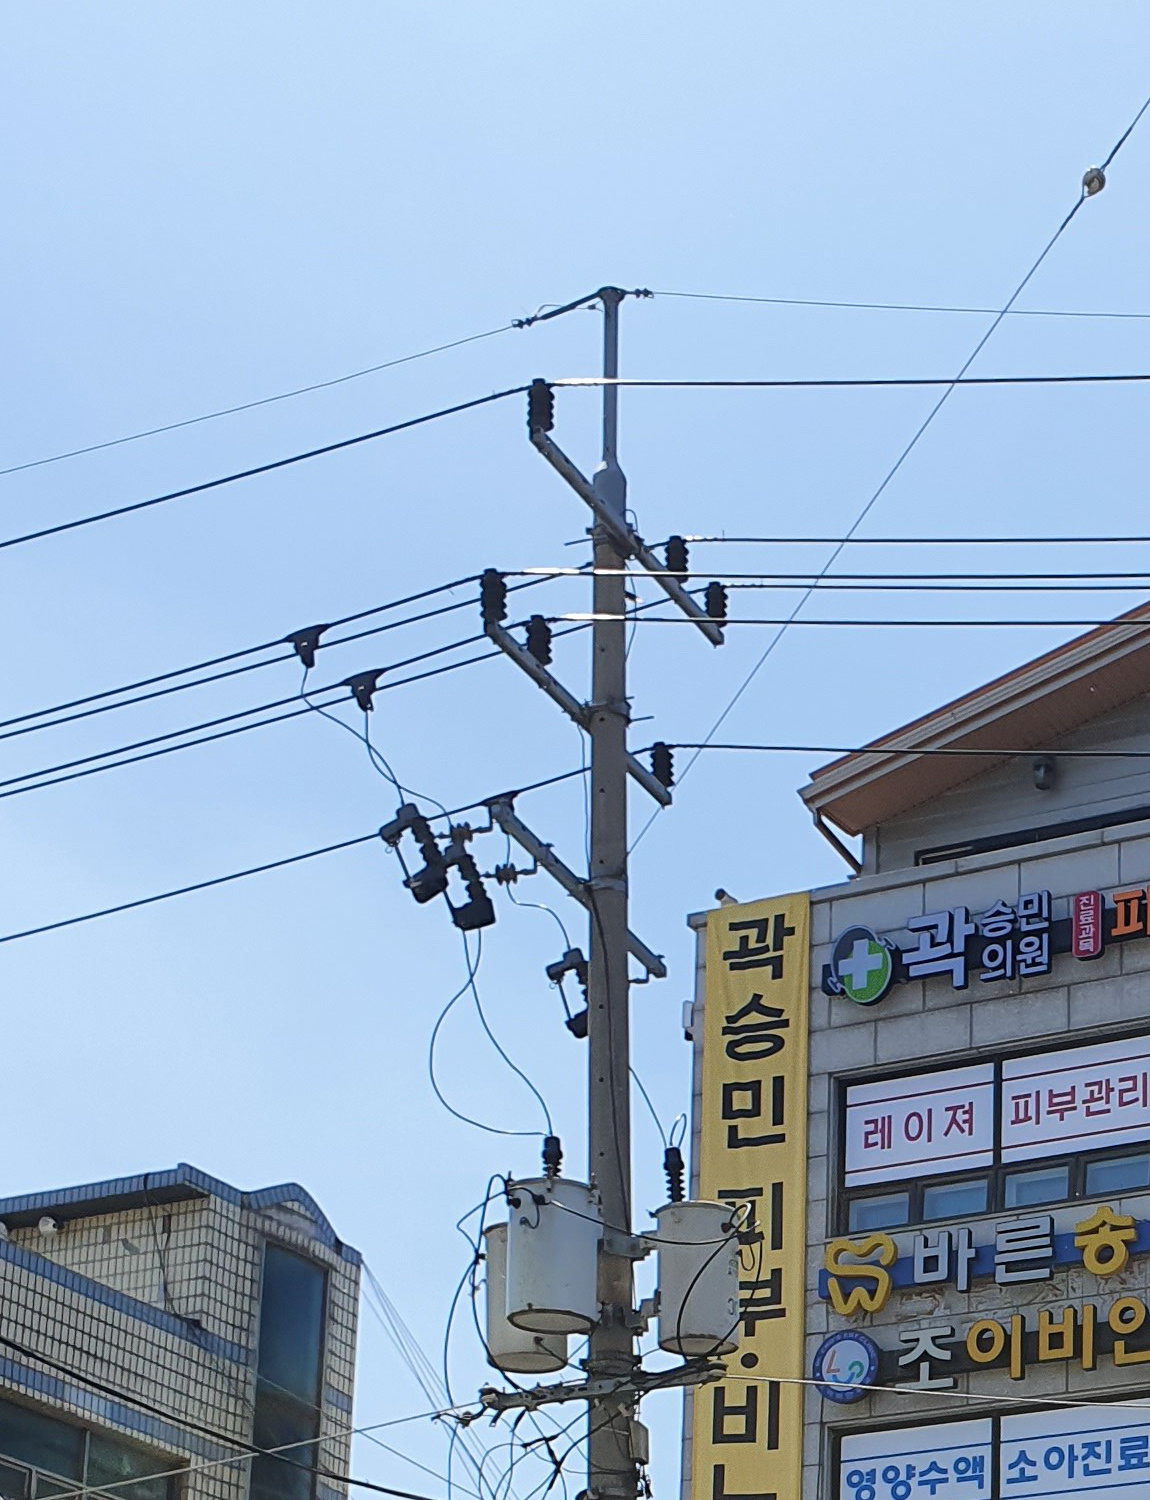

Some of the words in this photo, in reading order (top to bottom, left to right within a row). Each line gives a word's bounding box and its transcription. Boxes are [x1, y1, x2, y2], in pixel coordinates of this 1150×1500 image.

[863, 1100, 975, 1151] 레이져
[1011, 1072, 1149, 1128] 피부관리
[1007, 1435, 1150, 1483] 소아진료
